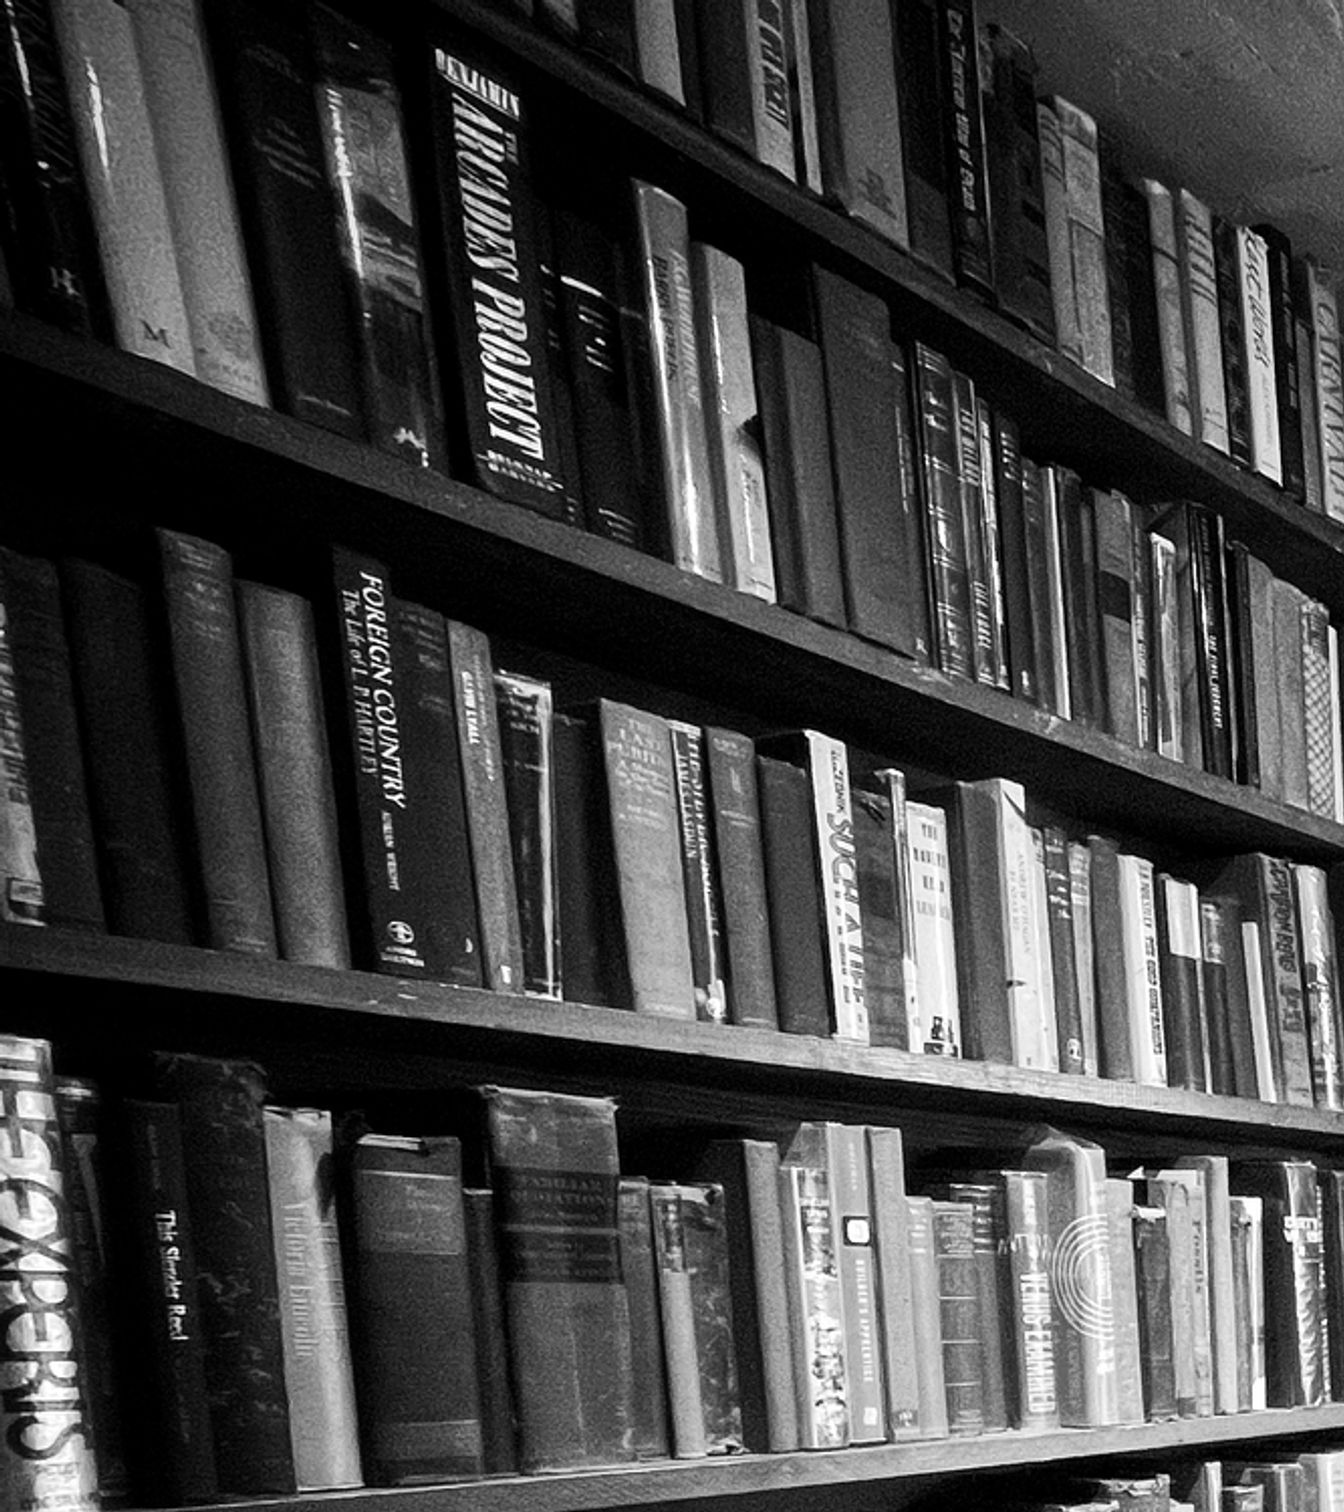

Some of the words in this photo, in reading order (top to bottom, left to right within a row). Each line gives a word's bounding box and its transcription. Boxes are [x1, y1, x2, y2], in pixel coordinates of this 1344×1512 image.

[451, 93, 520, 284] ARCADES
[470, 276, 546, 461] PROJECT
[342, 589, 363, 614] The
[359, 571, 393, 686] FOREIGN
[345, 619, 368, 648] Life
[355, 699, 379, 779] HARTLEY
[373, 688, 406, 809] COUNTRY
[682, 802, 697, 859] LASDUN
[1017, 853, 1028, 902] ANDREW
[155, 1209, 179, 1244] This
[159, 1245, 184, 1301] Slender
[1020, 1272, 1052, 1325] VENUS
[168, 1303, 191, 1342] Reed
